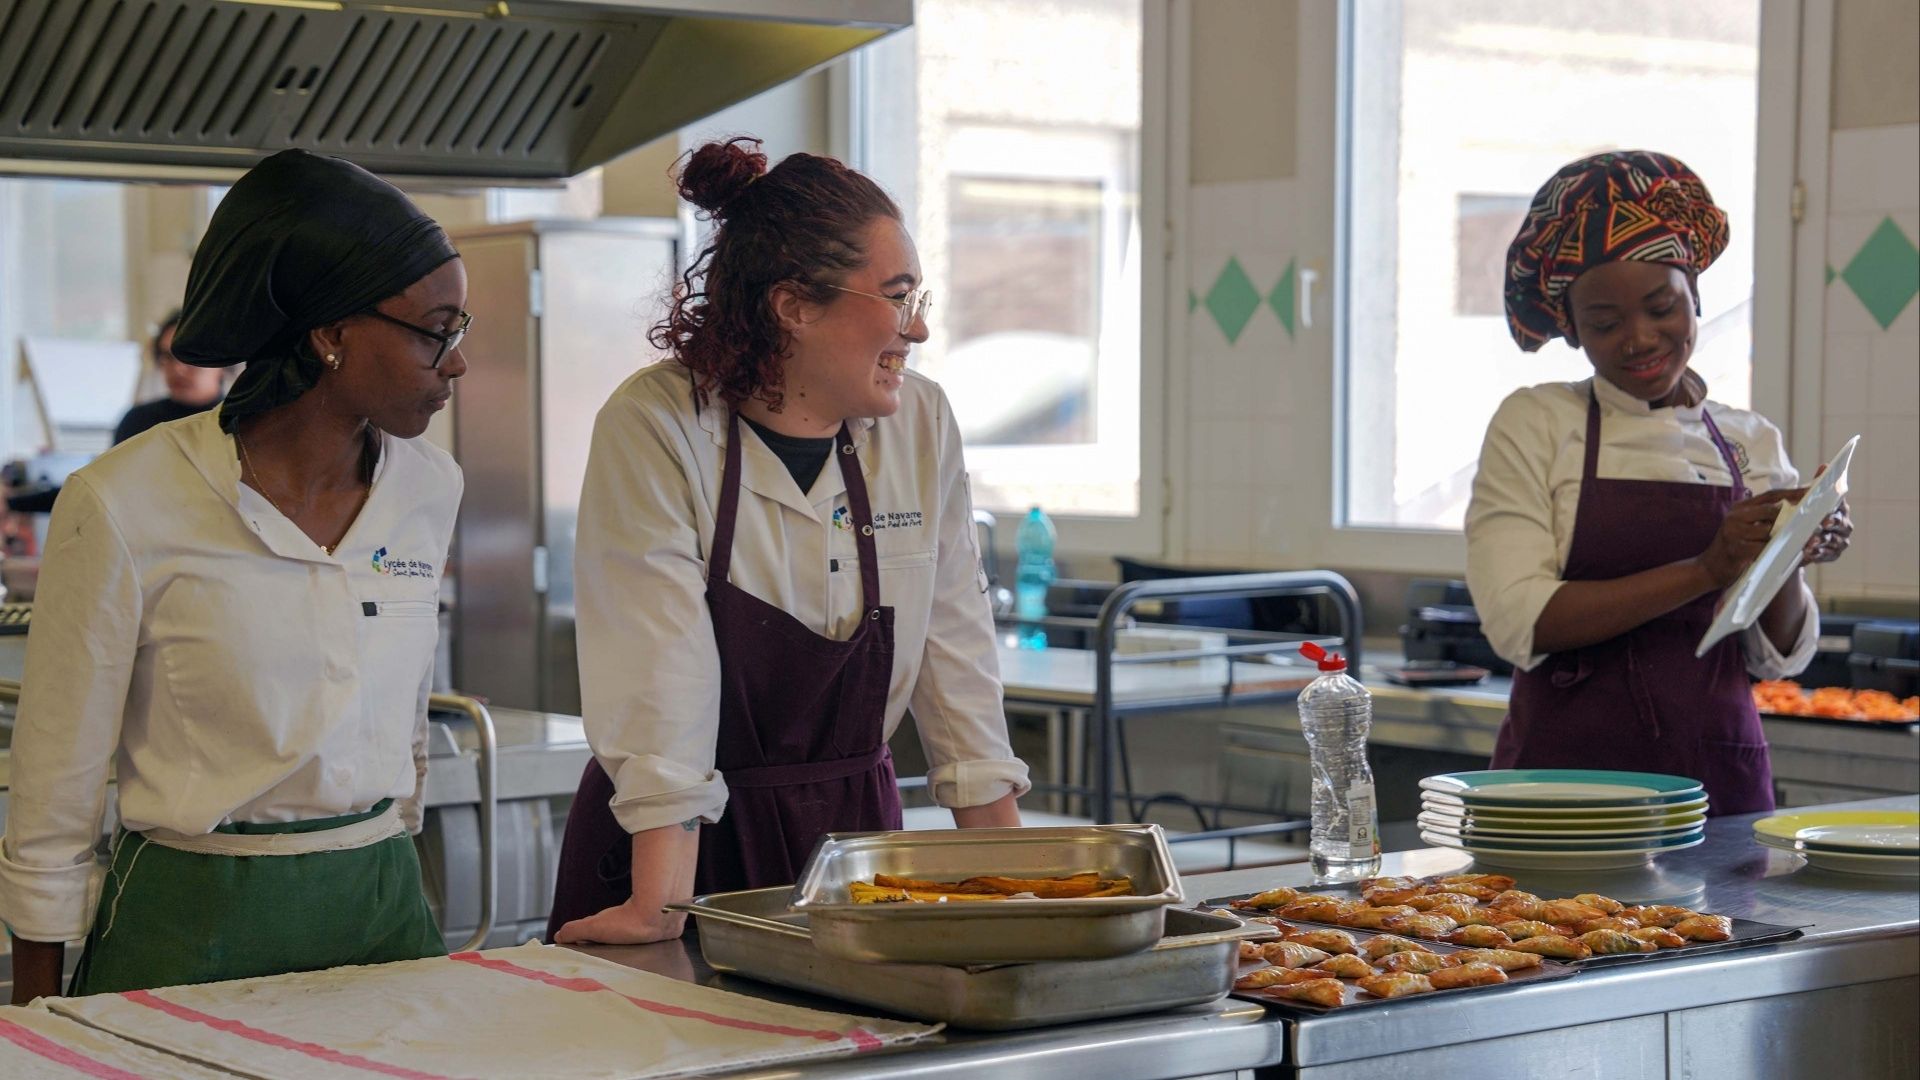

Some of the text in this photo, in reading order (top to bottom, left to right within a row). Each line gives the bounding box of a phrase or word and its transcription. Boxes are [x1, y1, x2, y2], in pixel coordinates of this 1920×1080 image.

[874, 511, 922, 521] de Navarre
[383, 558, 407, 571] Lycée
[408, 559, 417, 568] de
